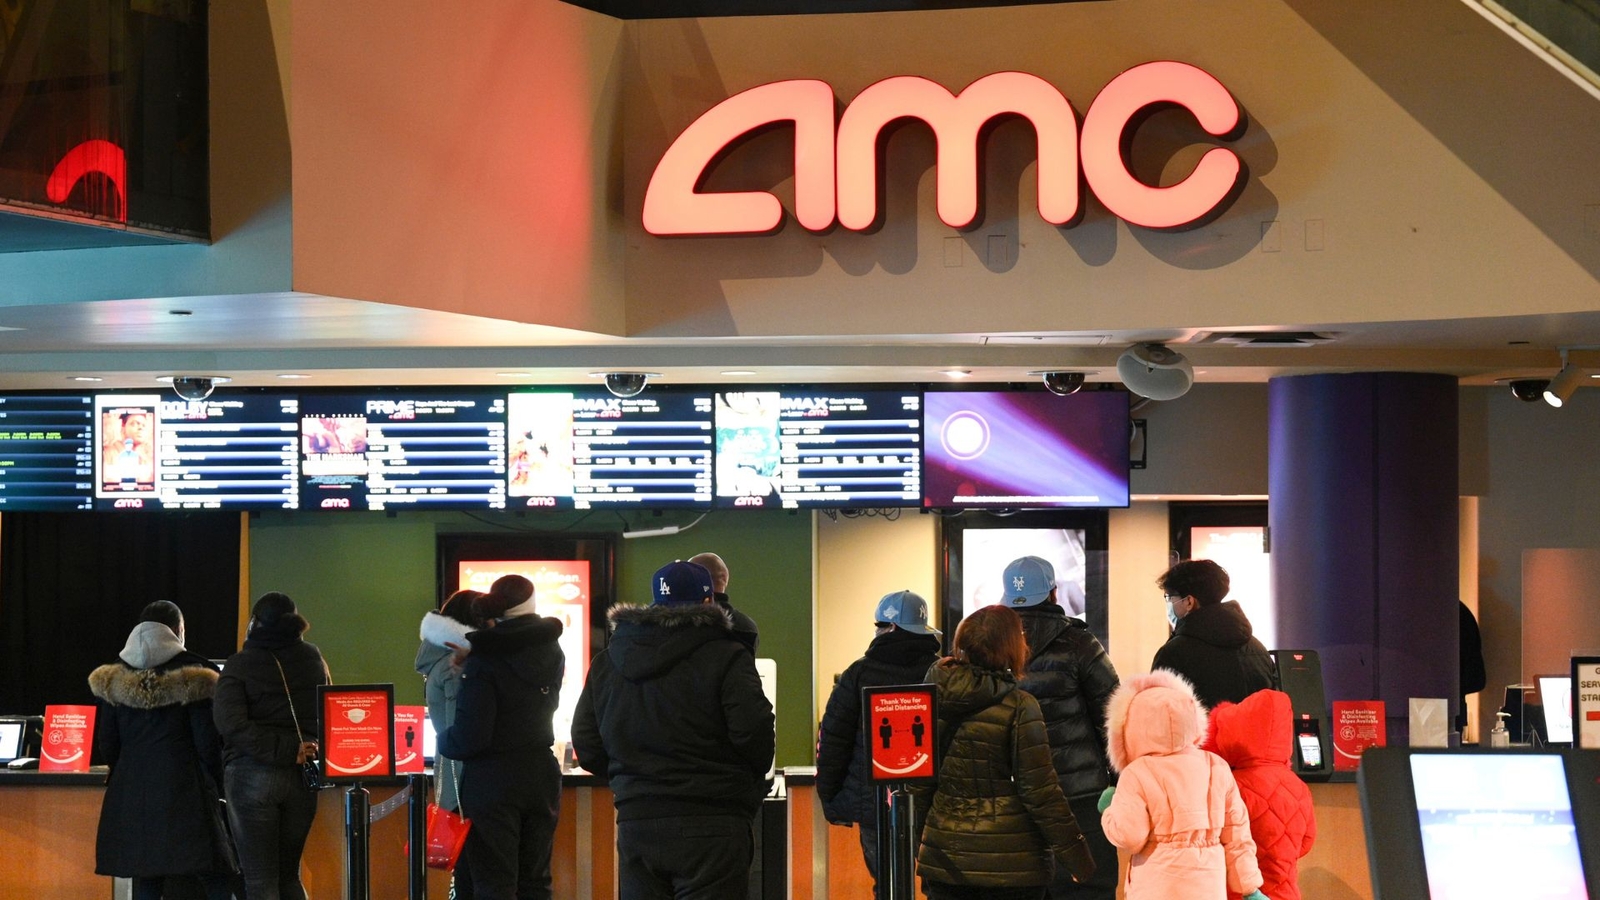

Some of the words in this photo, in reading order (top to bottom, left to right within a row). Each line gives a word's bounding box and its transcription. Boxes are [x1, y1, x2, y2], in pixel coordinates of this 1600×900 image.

[642, 60, 1240, 235] amc
[366, 400, 415, 414] PRIME
[660, 577, 671, 594] LA
[894, 703, 927, 711] Distancing
